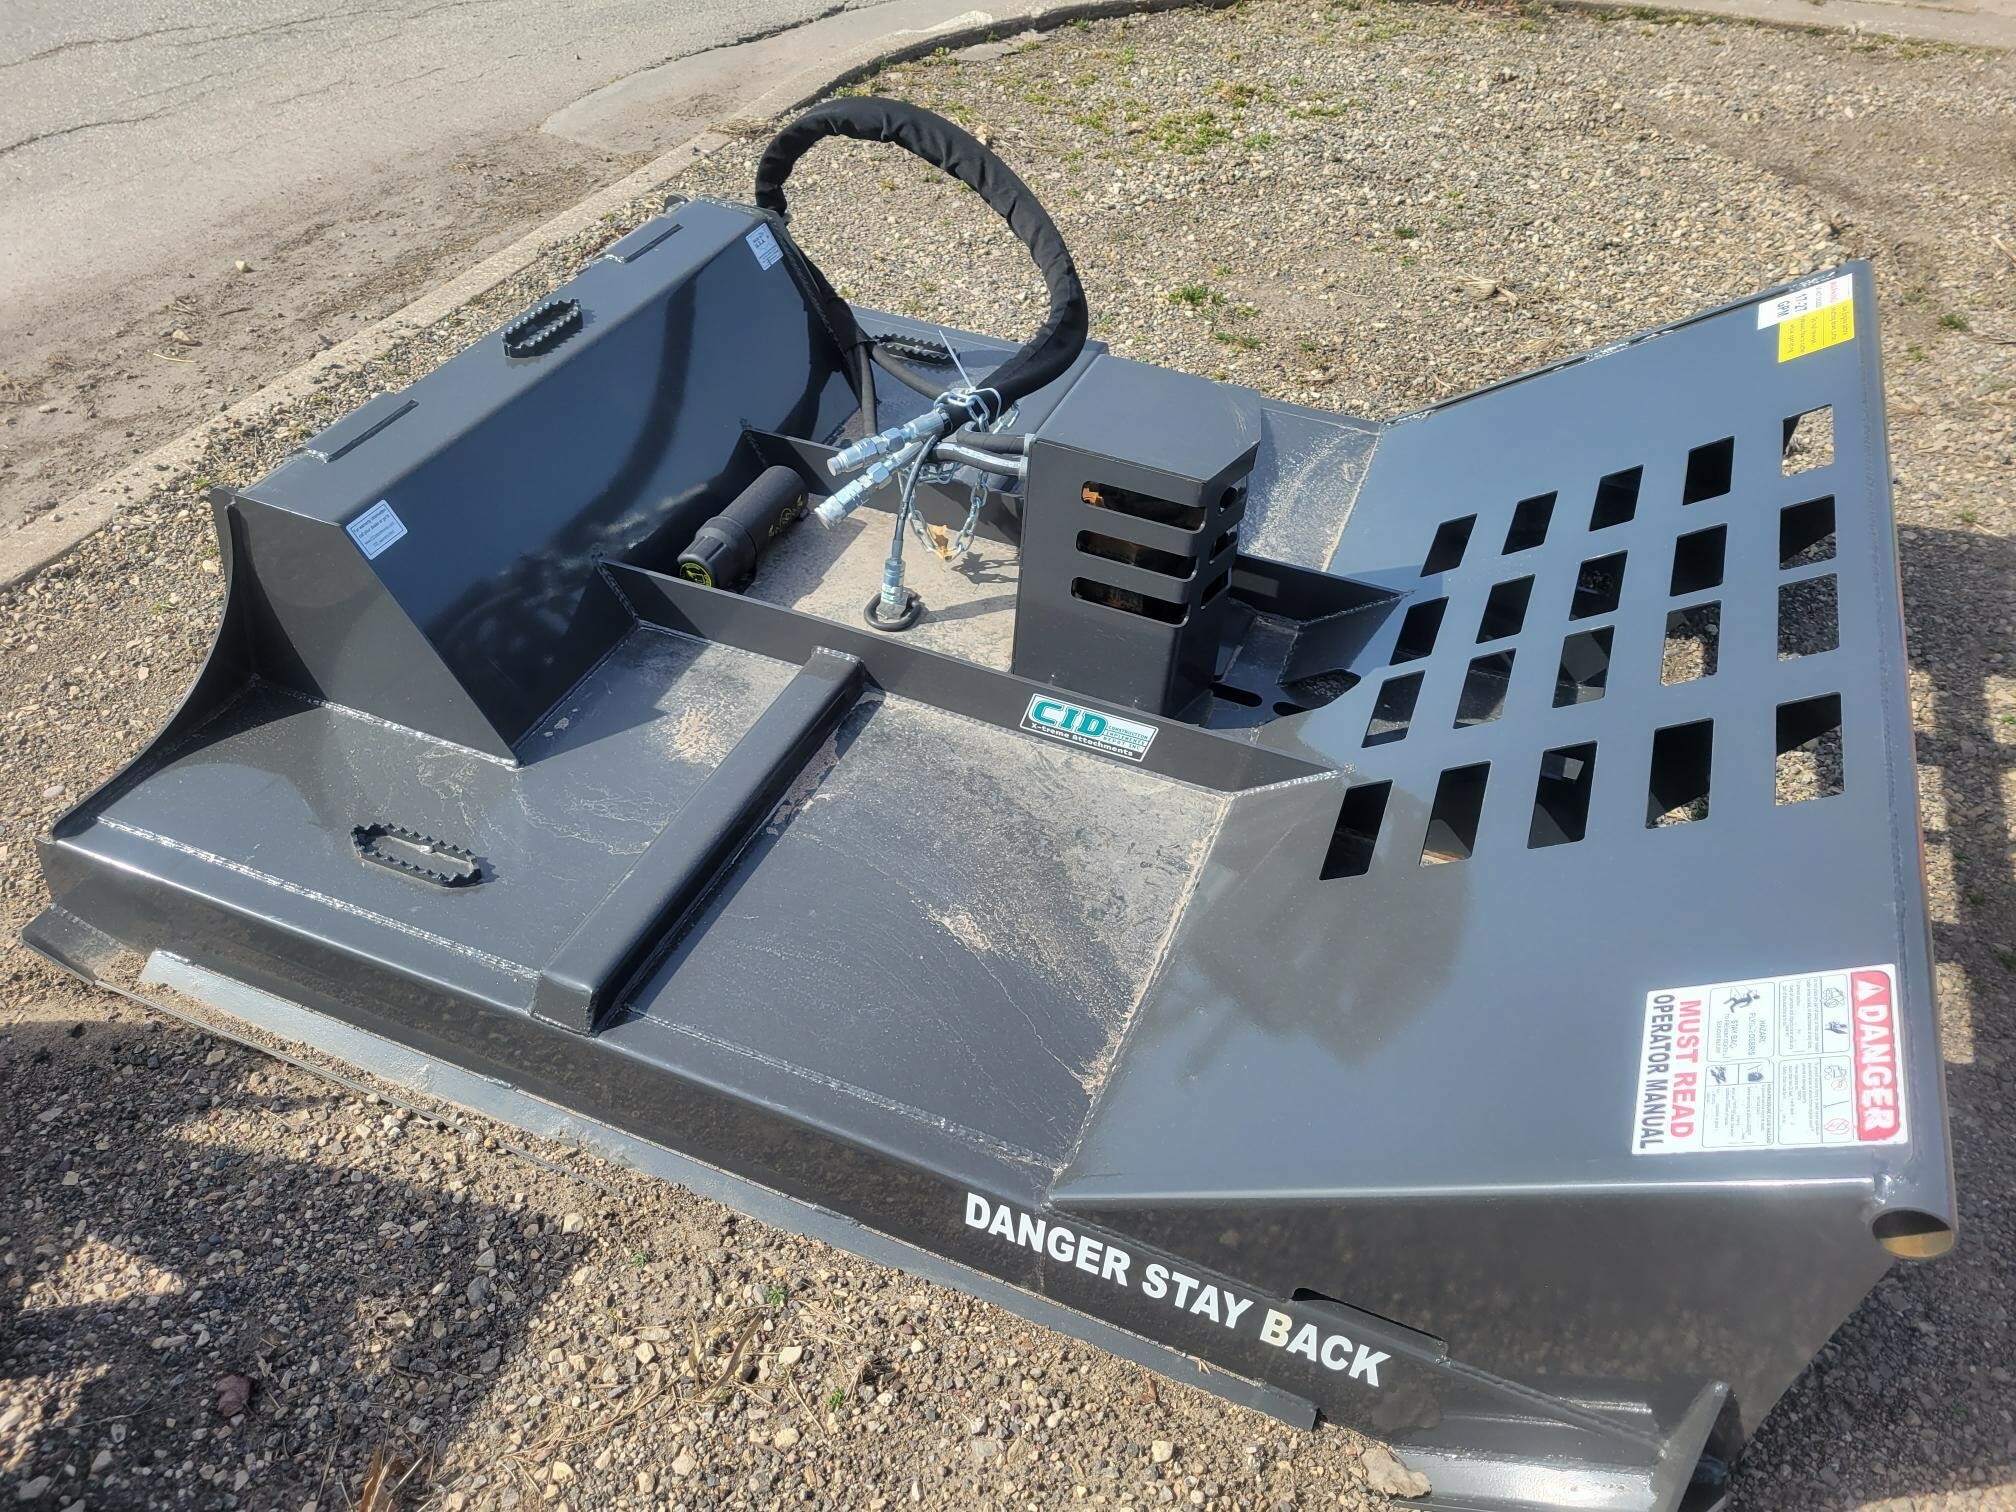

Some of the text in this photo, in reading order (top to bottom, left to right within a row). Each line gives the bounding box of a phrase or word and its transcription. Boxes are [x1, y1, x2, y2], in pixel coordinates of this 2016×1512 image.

[1031, 721, 1133, 758] X-treme Attachments
[1032, 700, 1107, 737] CID
[1639, 994, 1675, 1149] OPERATOR MANUAL
[1669, 999, 1702, 1138] MUST READ
[1856, 1004, 1896, 1131] DANGER
[965, 1192, 1391, 1388] DANGER STAY BACK
